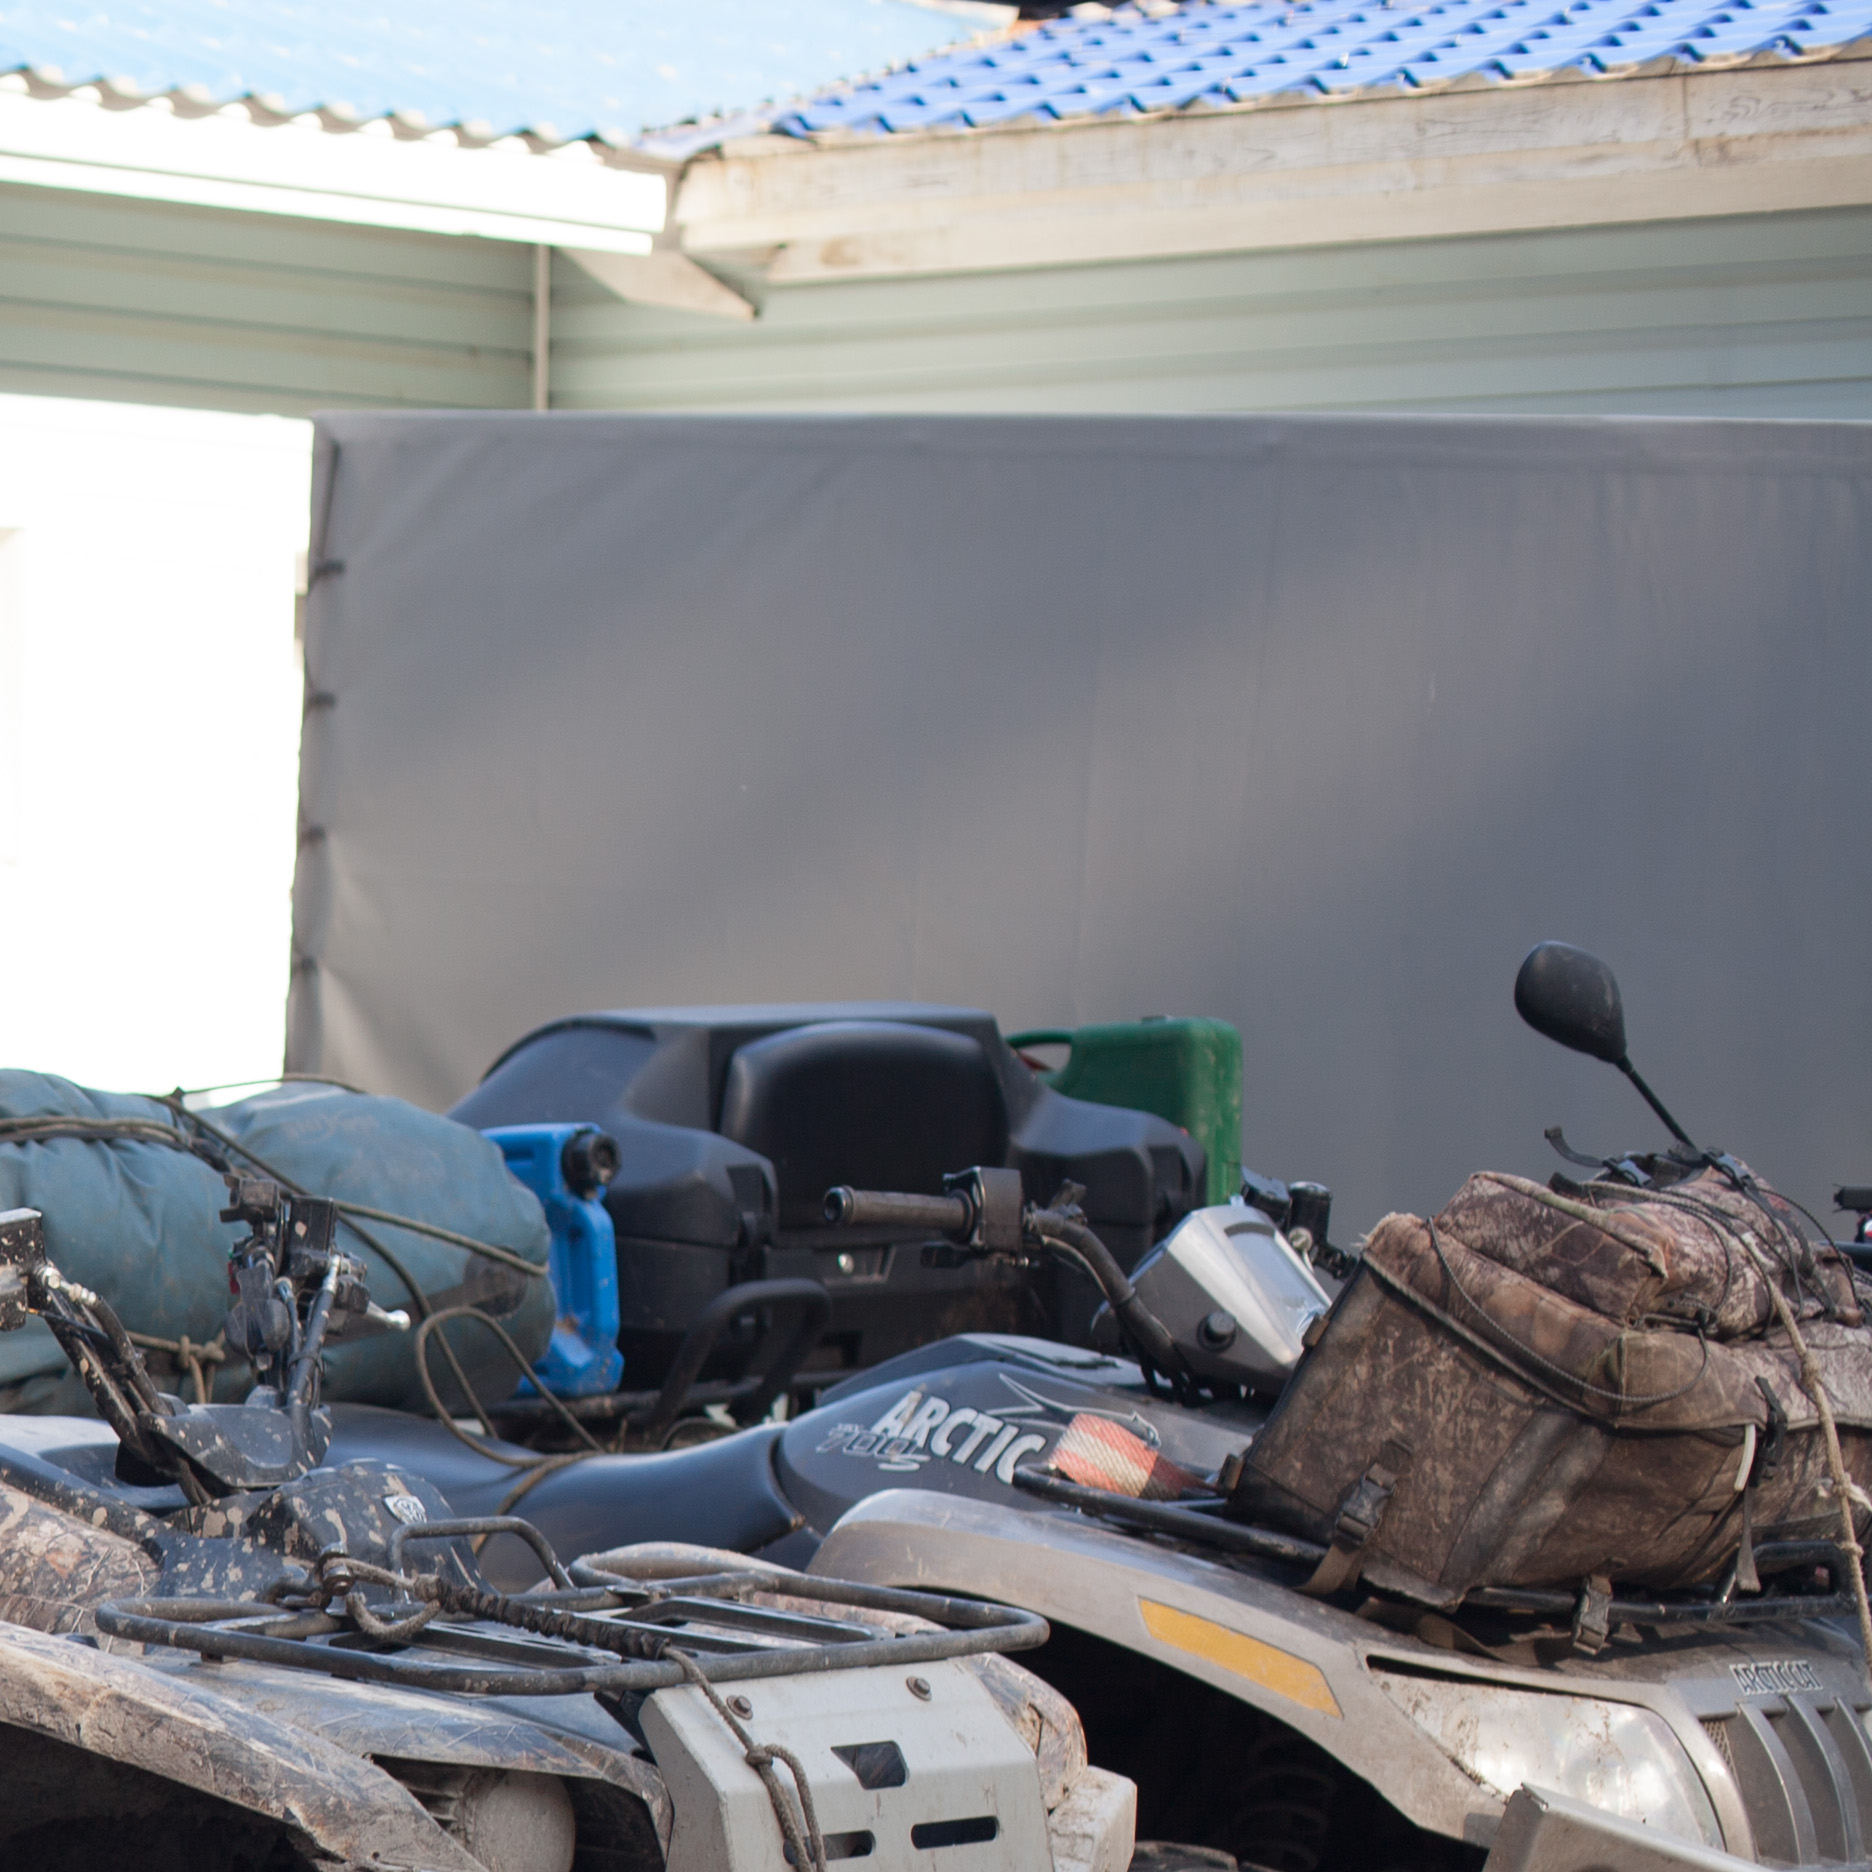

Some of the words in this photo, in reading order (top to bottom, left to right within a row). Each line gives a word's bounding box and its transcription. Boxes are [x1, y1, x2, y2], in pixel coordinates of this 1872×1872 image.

[871, 1390, 1046, 1485] ARCTIC
[1729, 1661, 1798, 1695] ARCTIC
[1784, 1660, 1823, 1691] CAT
